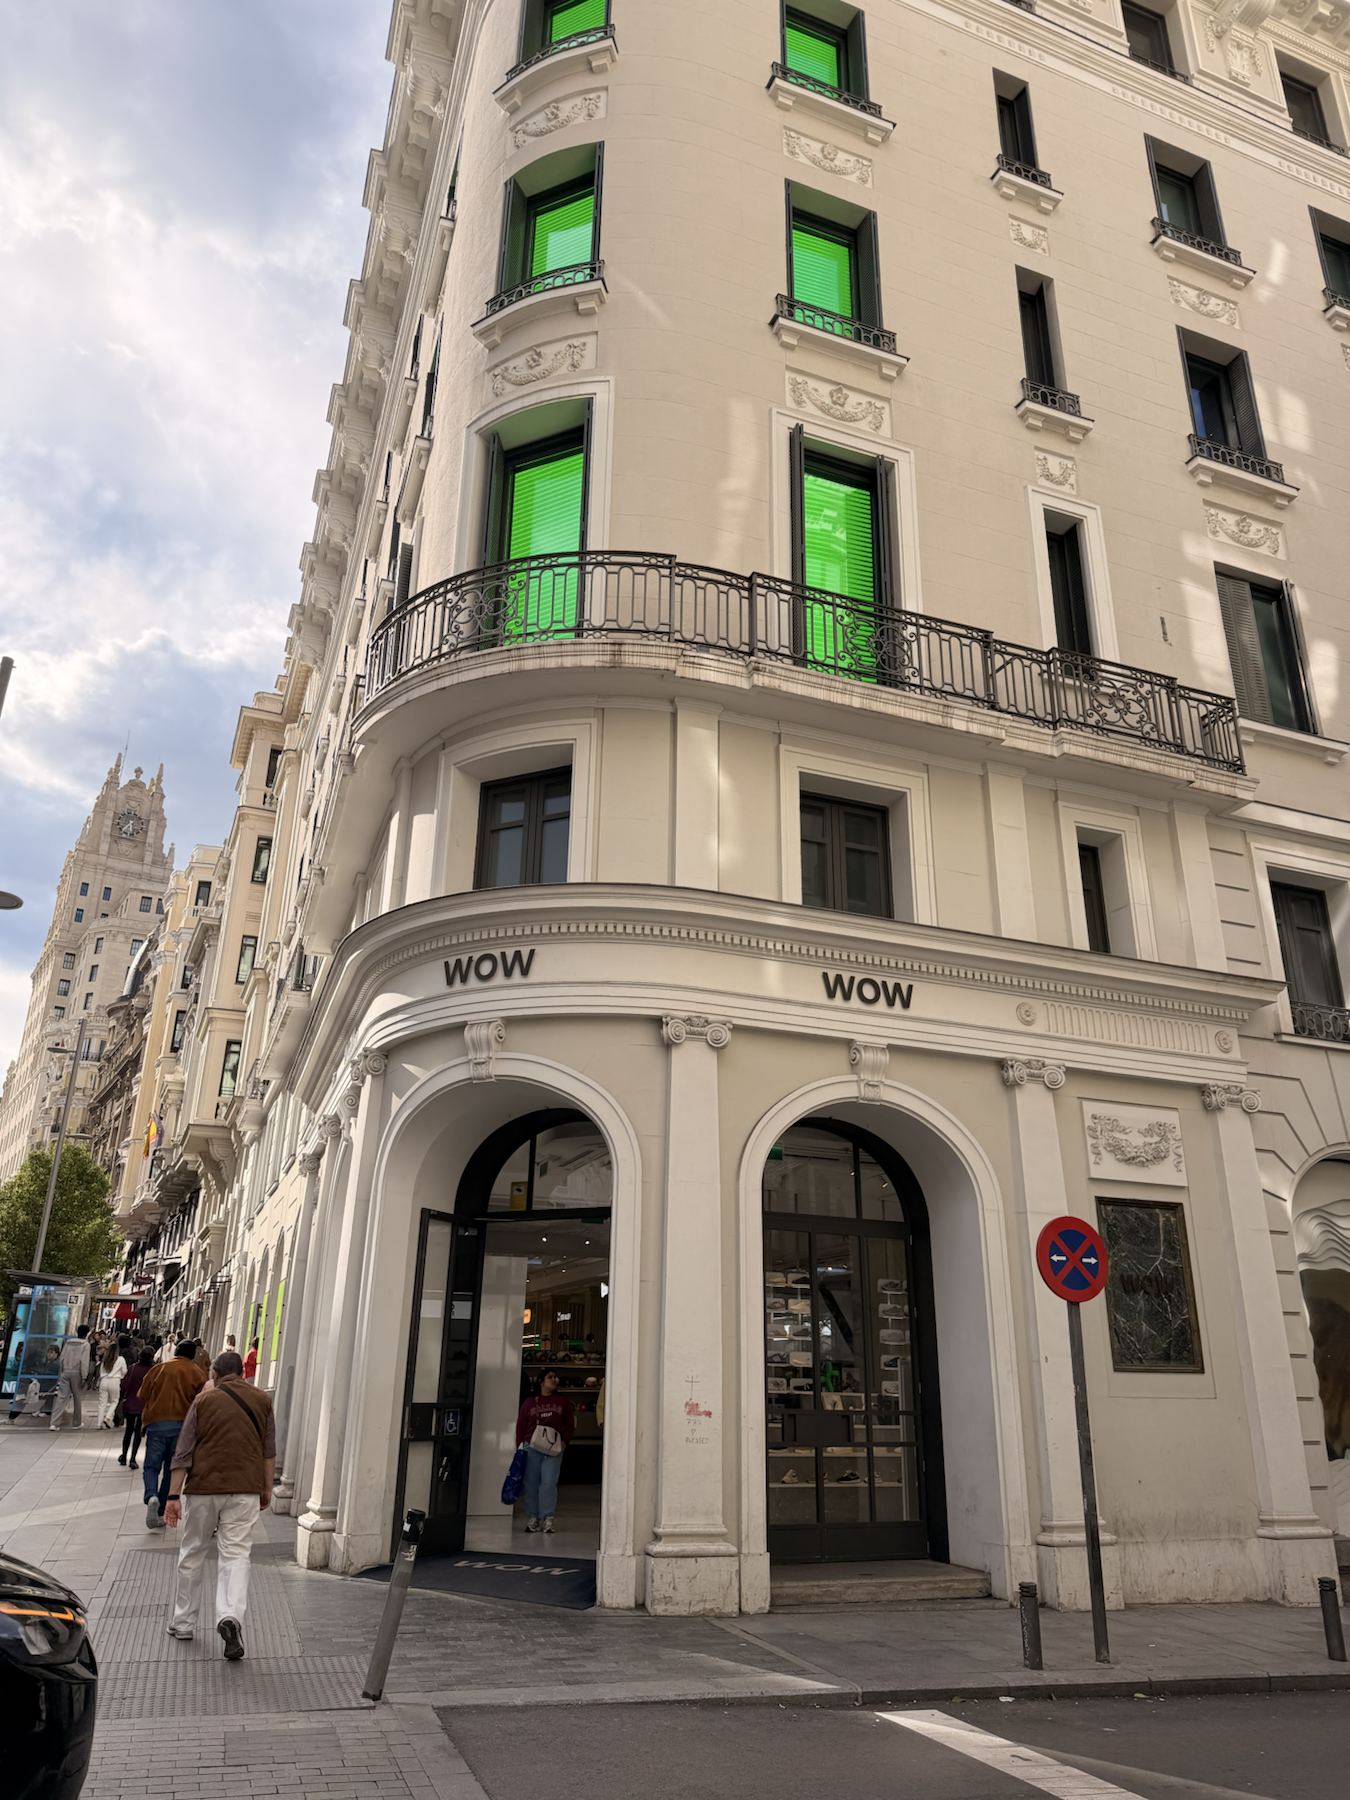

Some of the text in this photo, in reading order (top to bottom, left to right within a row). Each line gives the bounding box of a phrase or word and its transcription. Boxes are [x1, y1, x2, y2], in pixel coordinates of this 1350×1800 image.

[444, 948, 536, 986] WOW
[822, 971, 913, 1009] WOW
[1120, 1273, 1175, 1297] WOW
[453, 1560, 581, 1576] WOW
